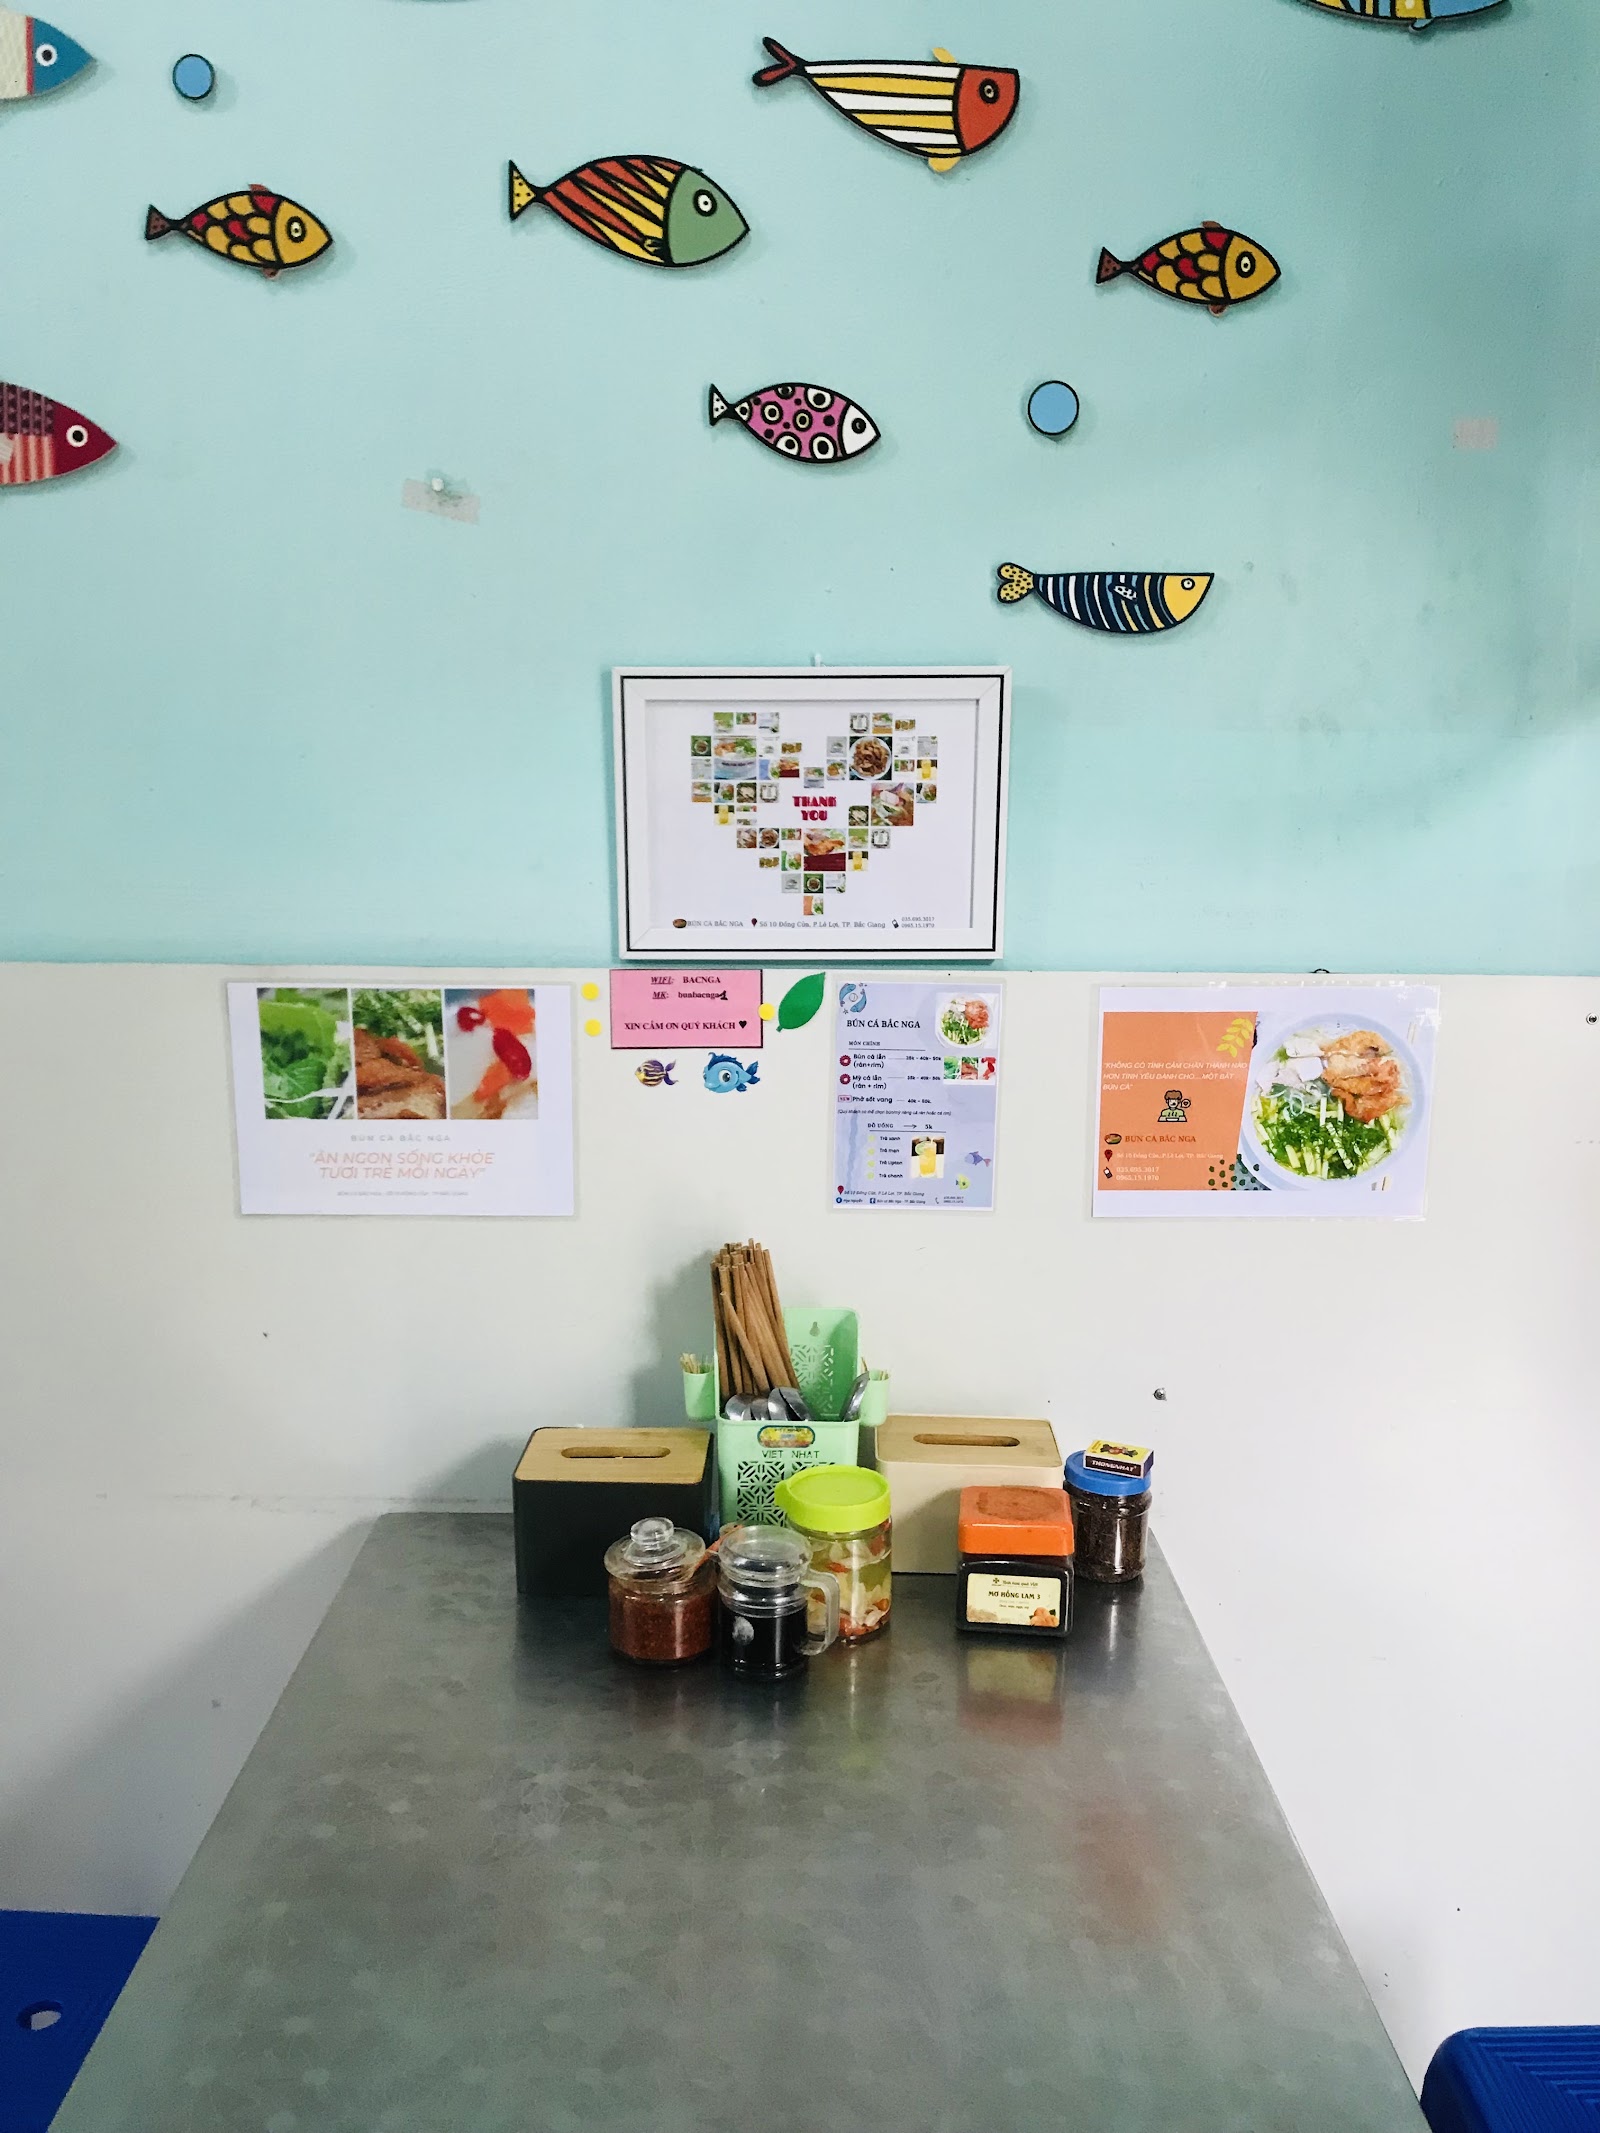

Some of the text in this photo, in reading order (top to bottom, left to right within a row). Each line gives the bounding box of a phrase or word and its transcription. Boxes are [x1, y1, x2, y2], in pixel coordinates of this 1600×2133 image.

[792, 795, 837, 807] THANK
[801, 810, 827, 821] YOU
[867, 921, 886, 929] Giang
[651, 976, 674, 985] WIFI:
[652, 991, 669, 999] MK:
[624, 1022, 640, 1030] XIN
[642, 1020, 664, 1030] CẢM
[681, 1021, 700, 1031] QUÝ
[702, 1020, 736, 1030] KHÁCH
[867, 1018, 879, 1028] CÁ
[901, 1020, 921, 1029] NGA
[427, 1134, 451, 1142] NGA
[1178, 1135, 1197, 1143] NGA
[343, 1152, 392, 1164] NGON
[397, 1148, 444, 1164] SỐNG
[762, 1450, 820, 1458] VIET NHAT
[1000, 1589, 1020, 1598] HỒNG
